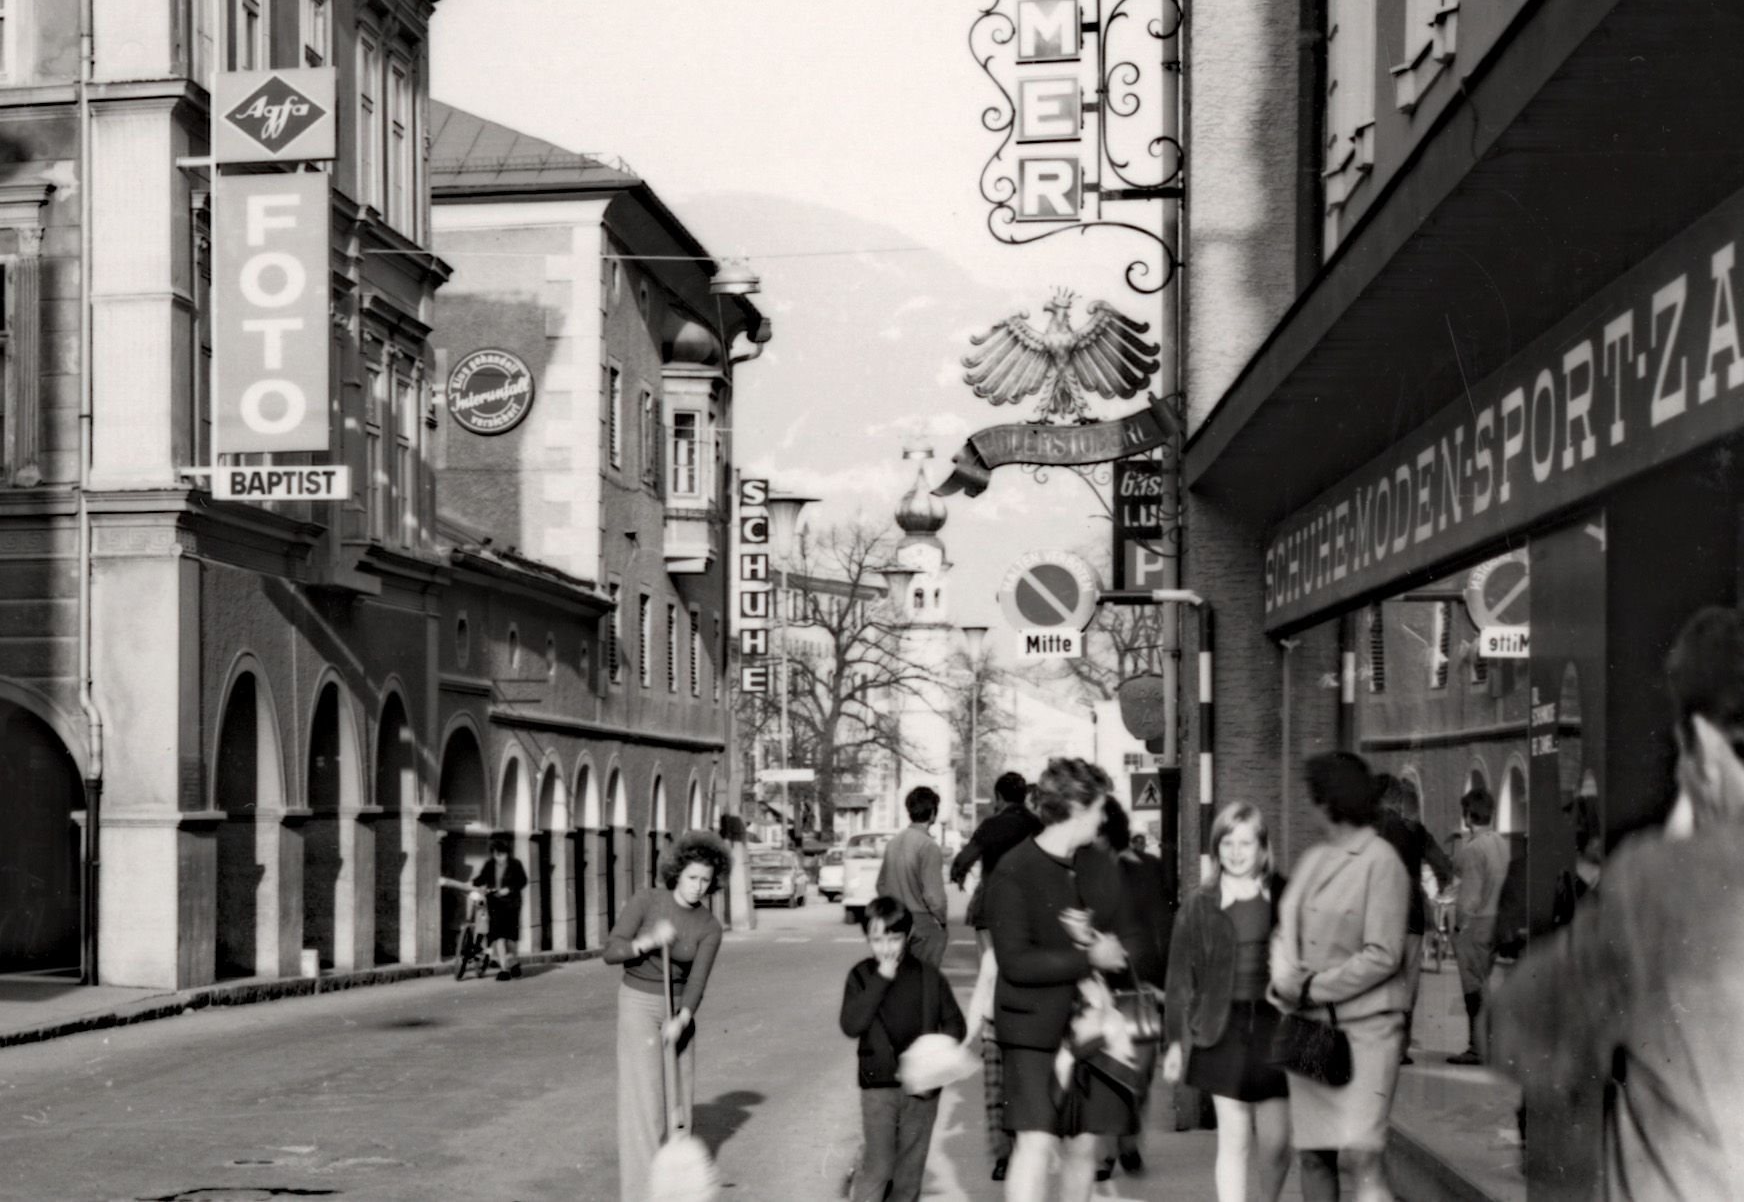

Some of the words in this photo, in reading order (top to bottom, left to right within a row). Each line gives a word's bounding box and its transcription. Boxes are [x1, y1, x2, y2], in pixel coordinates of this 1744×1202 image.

[235, 95, 309, 140] Agfa
[239, 193, 307, 435] FOTO
[229, 469, 337, 497] BAPTIST
[741, 480, 767, 692] SCHUHE
[1025, 634, 1073, 654] Mitte
